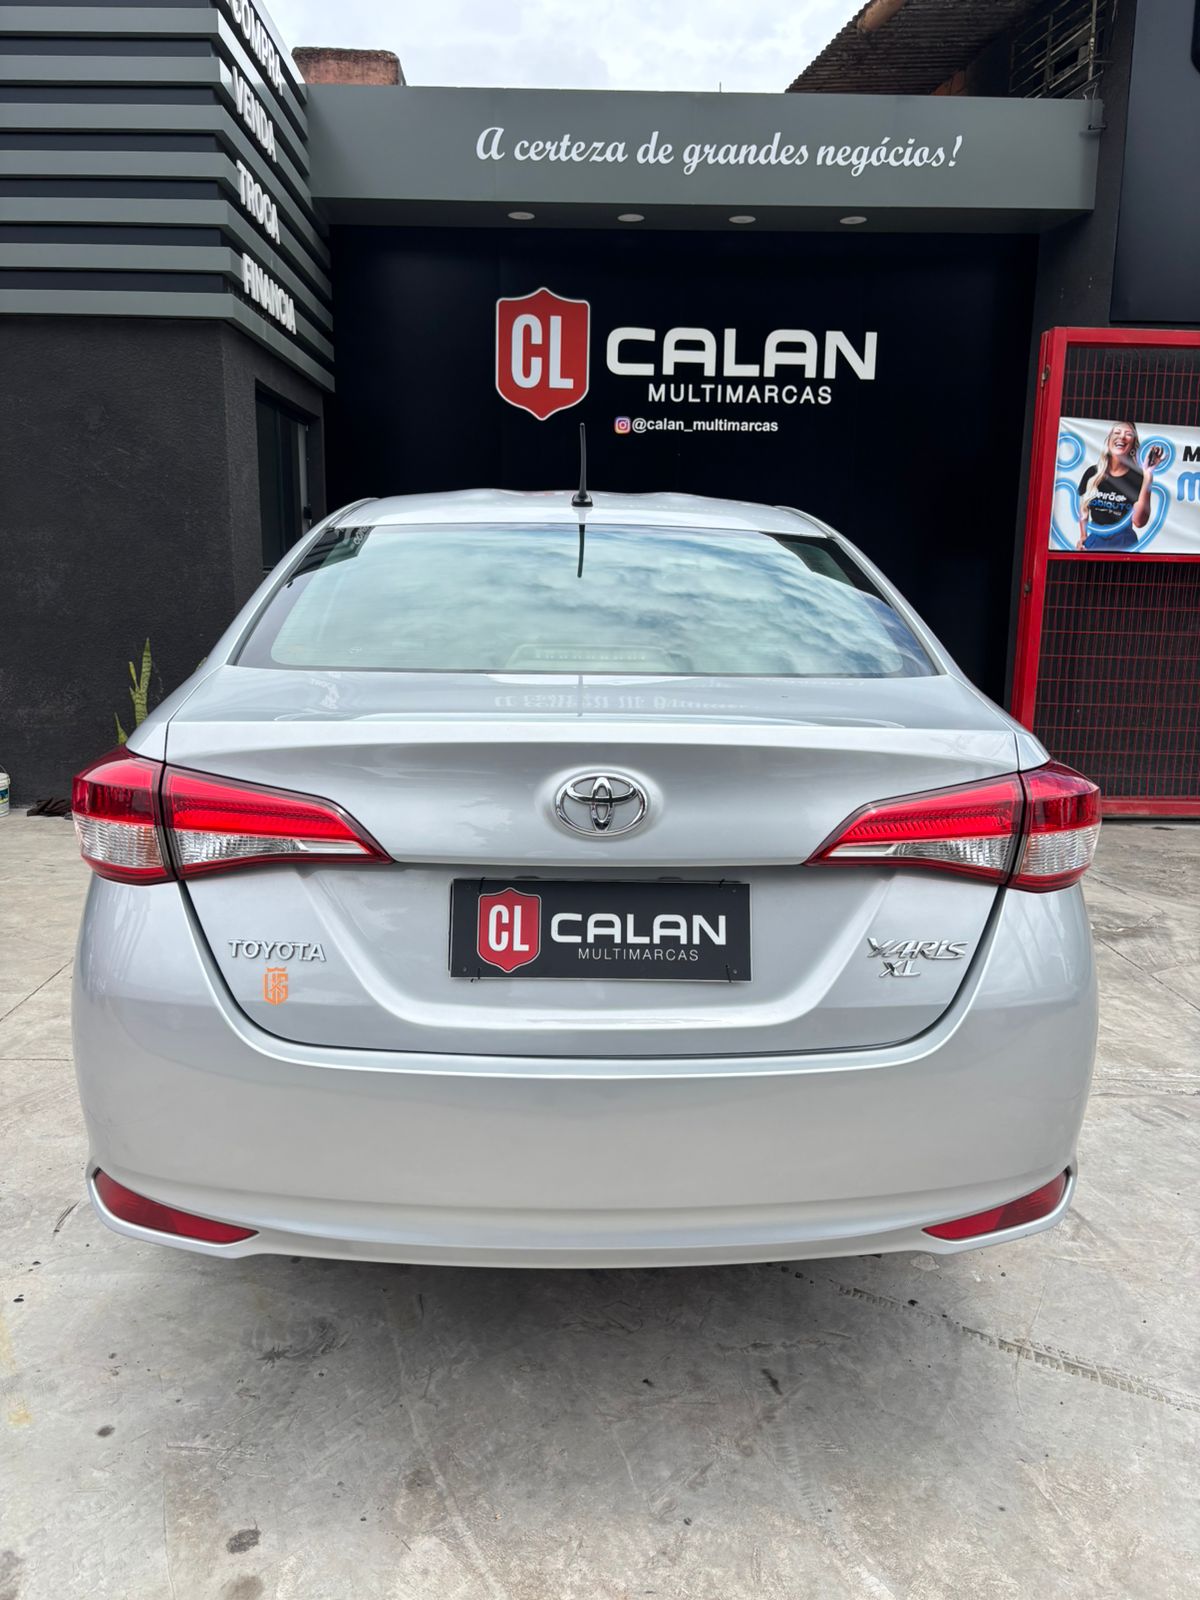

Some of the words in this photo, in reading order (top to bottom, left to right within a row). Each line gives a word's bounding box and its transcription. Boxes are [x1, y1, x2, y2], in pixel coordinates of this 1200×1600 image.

[231, 65, 277, 163] VENDA
[475, 126, 505, 161] A
[513, 133, 629, 164] certeza
[636, 130, 675, 165] de
[682, 131, 809, 176] grandes
[816, 134, 964, 177] negócios!
[236, 159, 280, 245] TROCA
[242, 252, 297, 336] FINANCIA
[511, 313, 574, 389] CL
[606, 327, 878, 380] CALAN
[647, 383, 833, 405] MULTIMARCAS
[631, 417, 779, 434] @calan_multimarcas
[488, 904, 530, 952] CL
[550, 912, 727, 946] CALAN
[228, 939, 327, 962] TOYOTA
[577, 947, 700, 962] MULTIMARCAS
[866, 938, 969, 961] YARIS
[878, 960, 921, 978] XL
